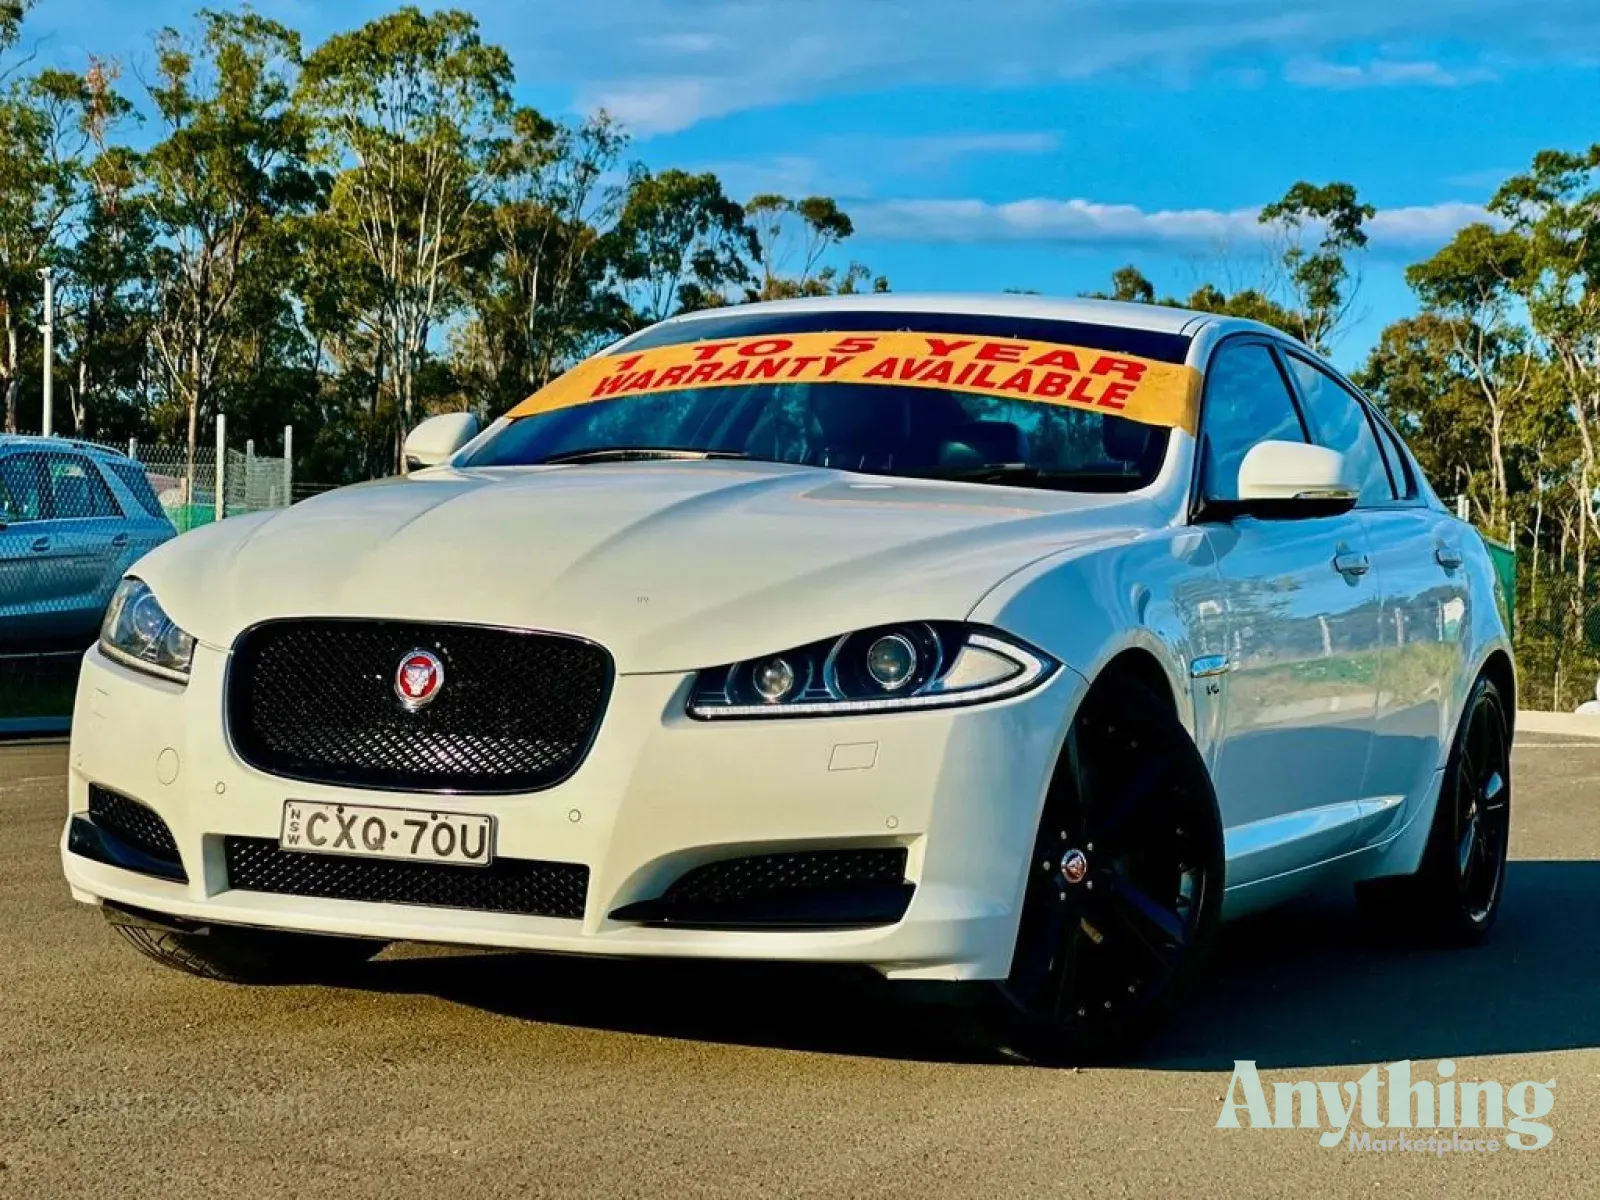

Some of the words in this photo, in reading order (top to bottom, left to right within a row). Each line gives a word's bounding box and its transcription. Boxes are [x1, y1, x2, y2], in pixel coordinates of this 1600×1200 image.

[590, 355, 855, 397] WARRANTY
[862, 357, 1138, 410] AVAILABLE
[615, 355, 644, 372] 1
[693, 338, 794, 361] TO
[828, 337, 879, 354] 5
[924, 338, 1148, 382] YEAR
